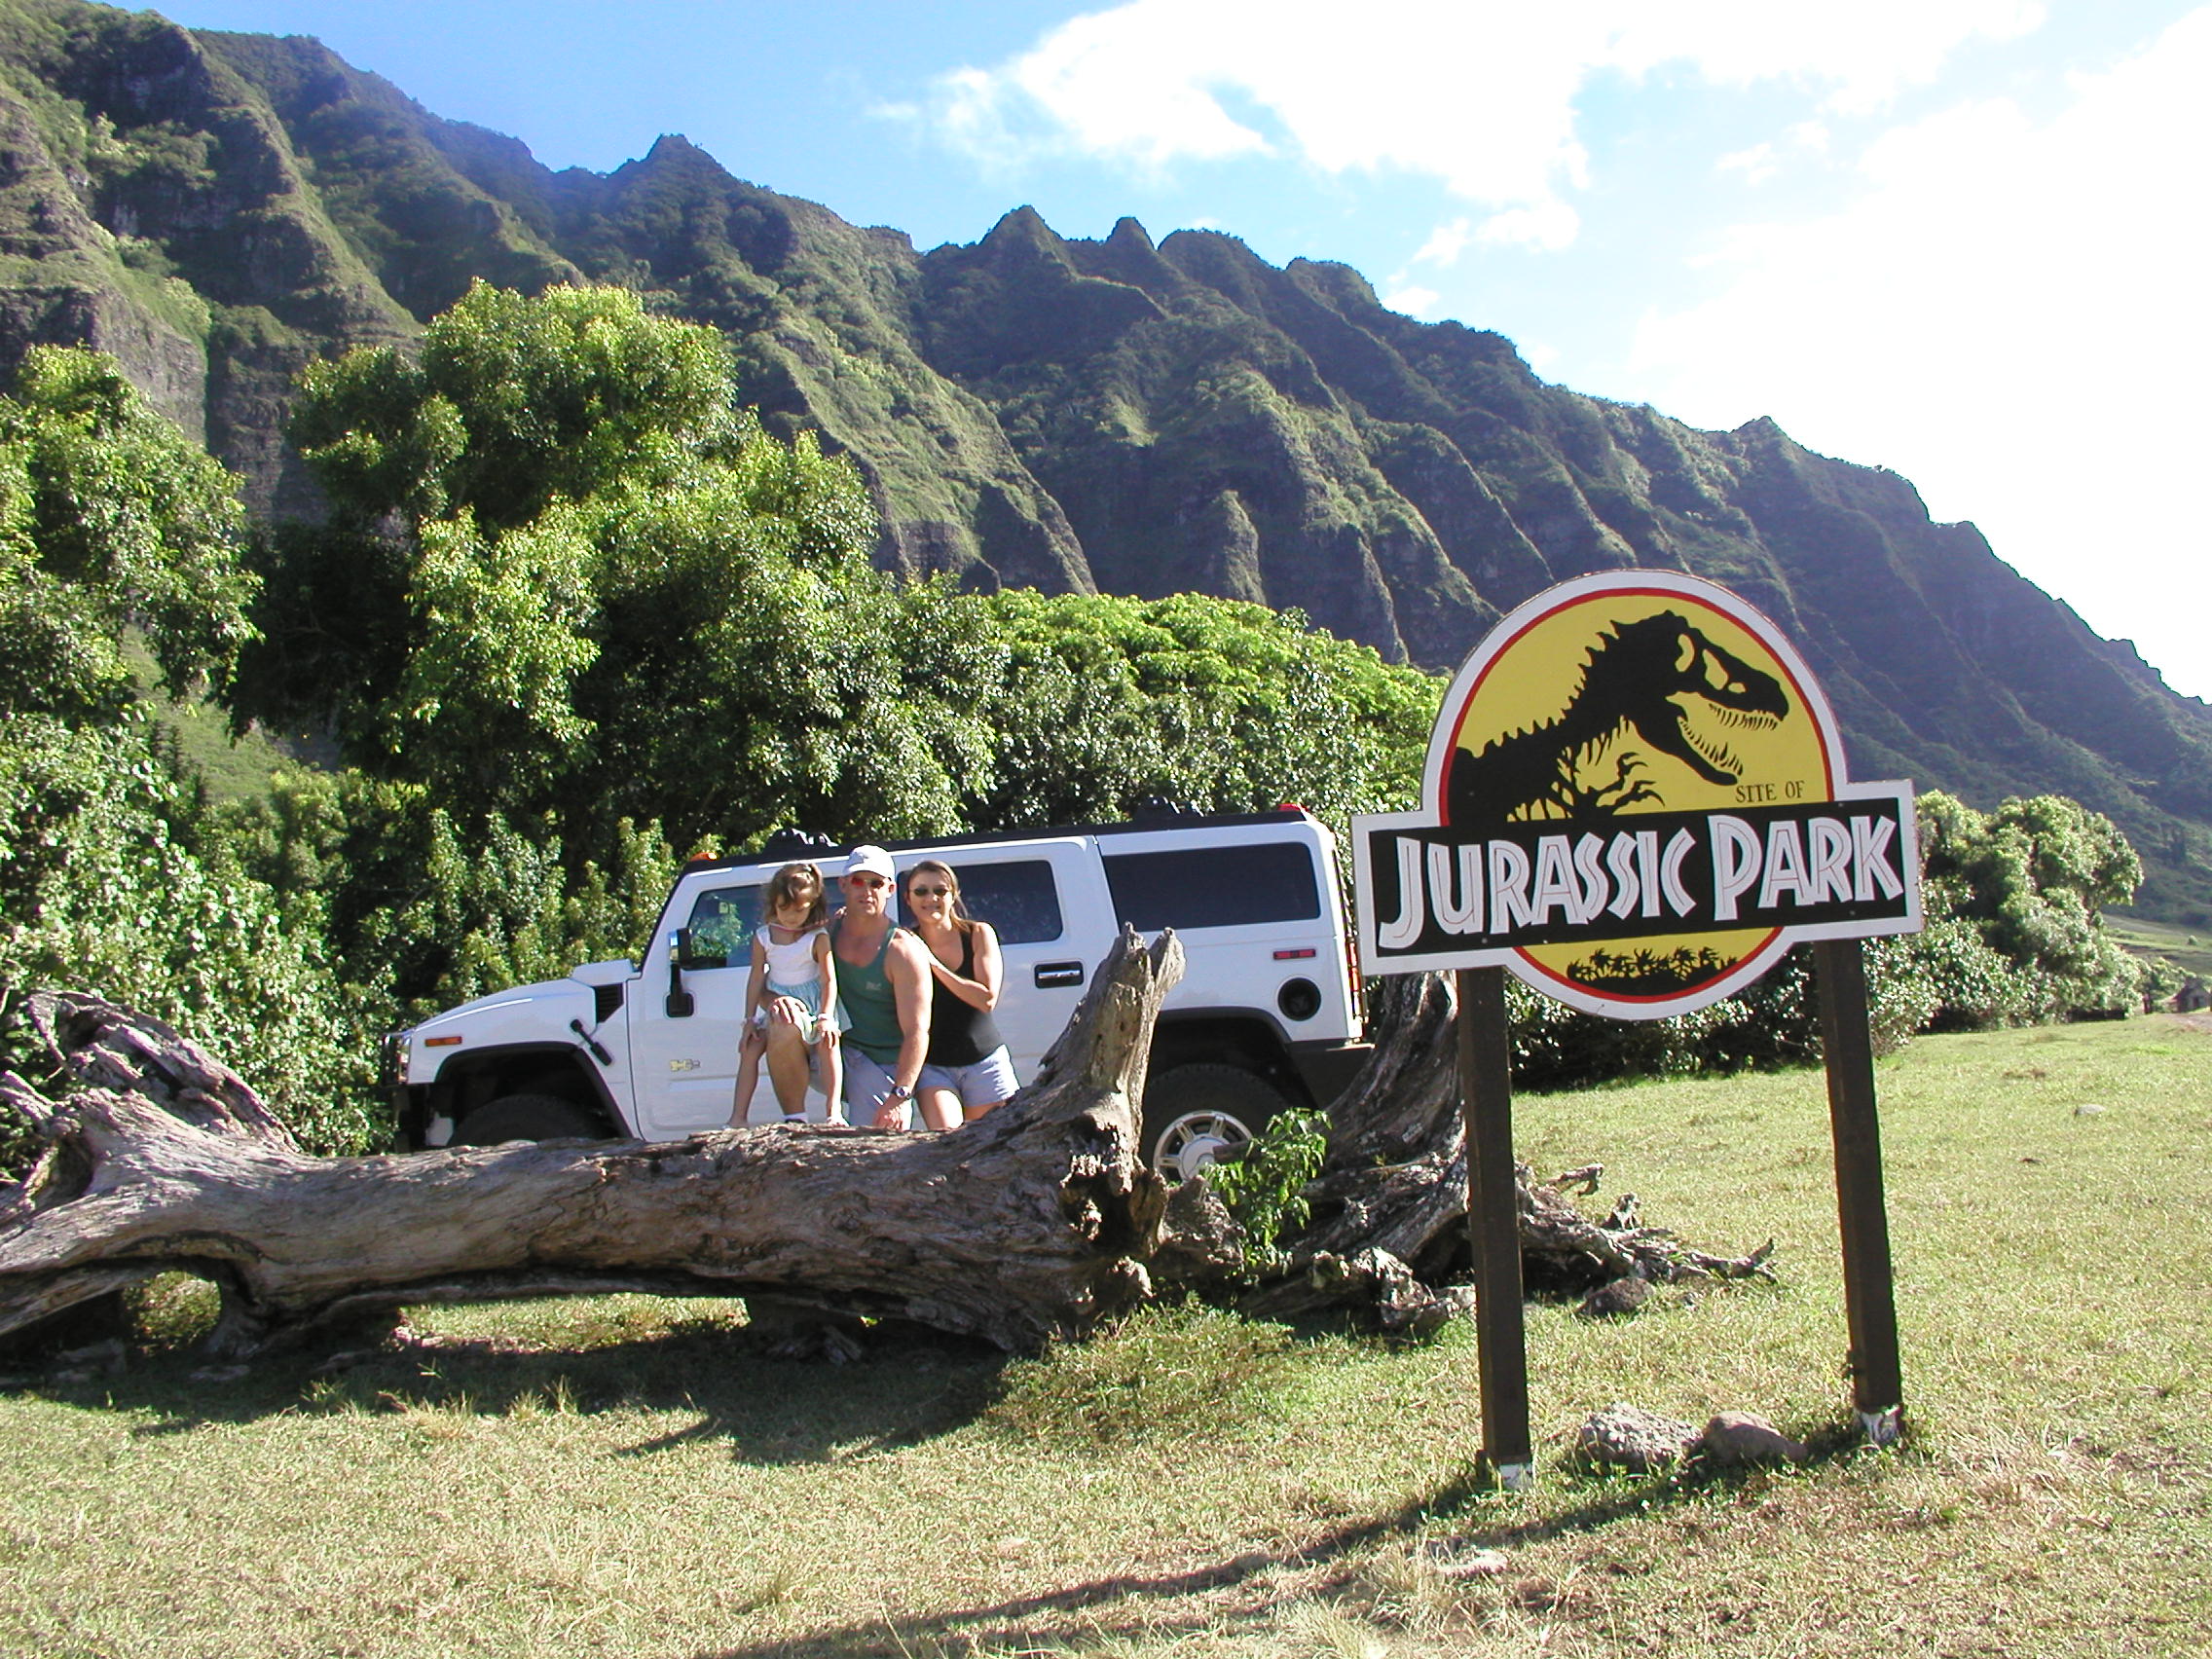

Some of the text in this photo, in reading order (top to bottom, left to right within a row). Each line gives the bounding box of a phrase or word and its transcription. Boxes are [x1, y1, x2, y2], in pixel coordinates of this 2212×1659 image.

[1736, 780, 1806, 803] SITE OF
[1379, 814, 1904, 949] JURASSIC PARK
